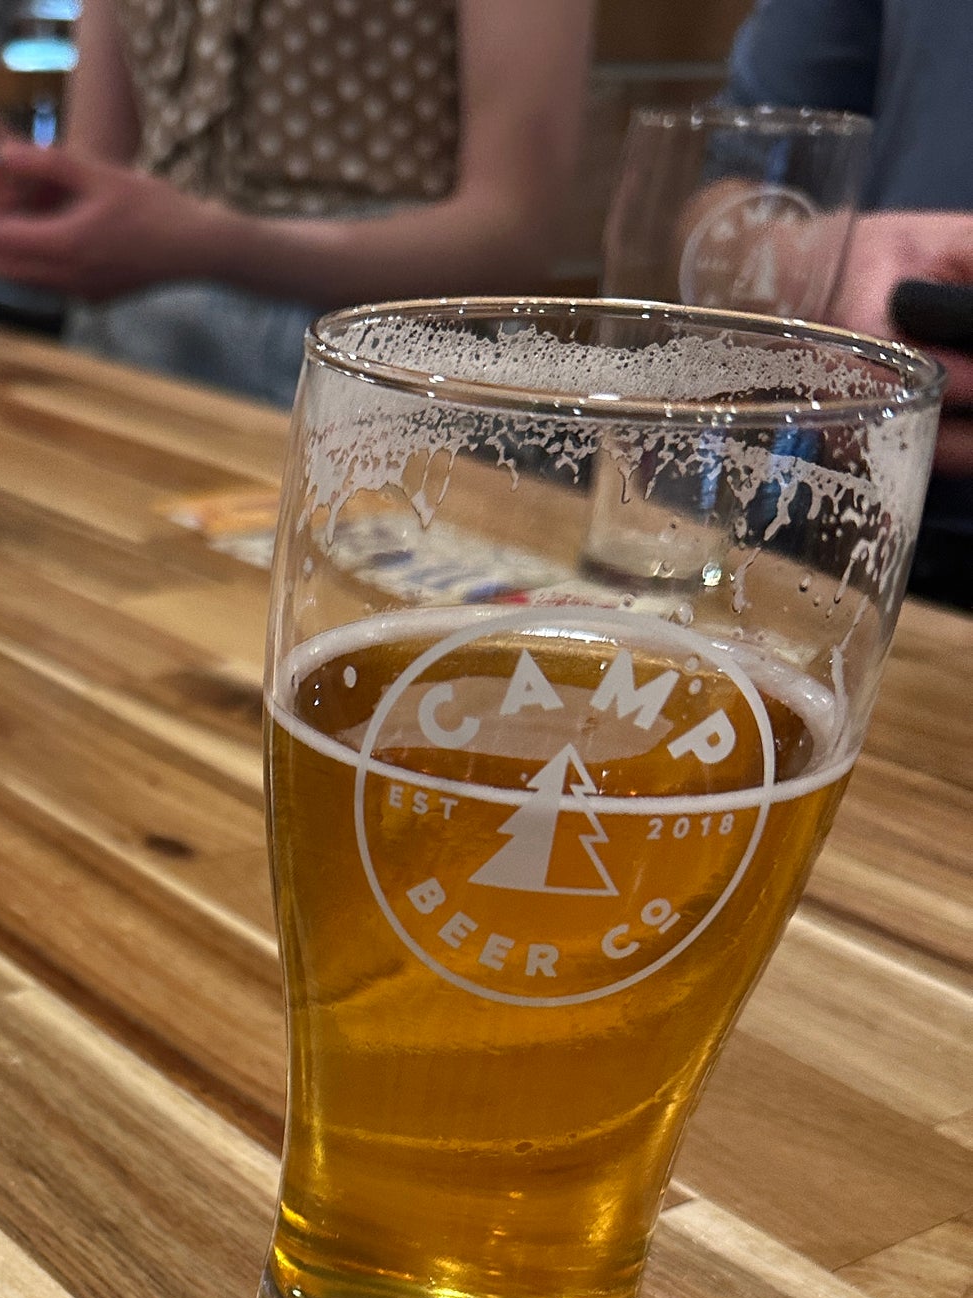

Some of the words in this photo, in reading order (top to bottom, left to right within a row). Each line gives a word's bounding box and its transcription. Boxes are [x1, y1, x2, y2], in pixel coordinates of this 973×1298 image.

[418, 648, 735, 765] CAMP
[388, 784, 459, 820] EST
[646, 813, 735, 840] 2018
[406, 877, 560, 978] BEER
